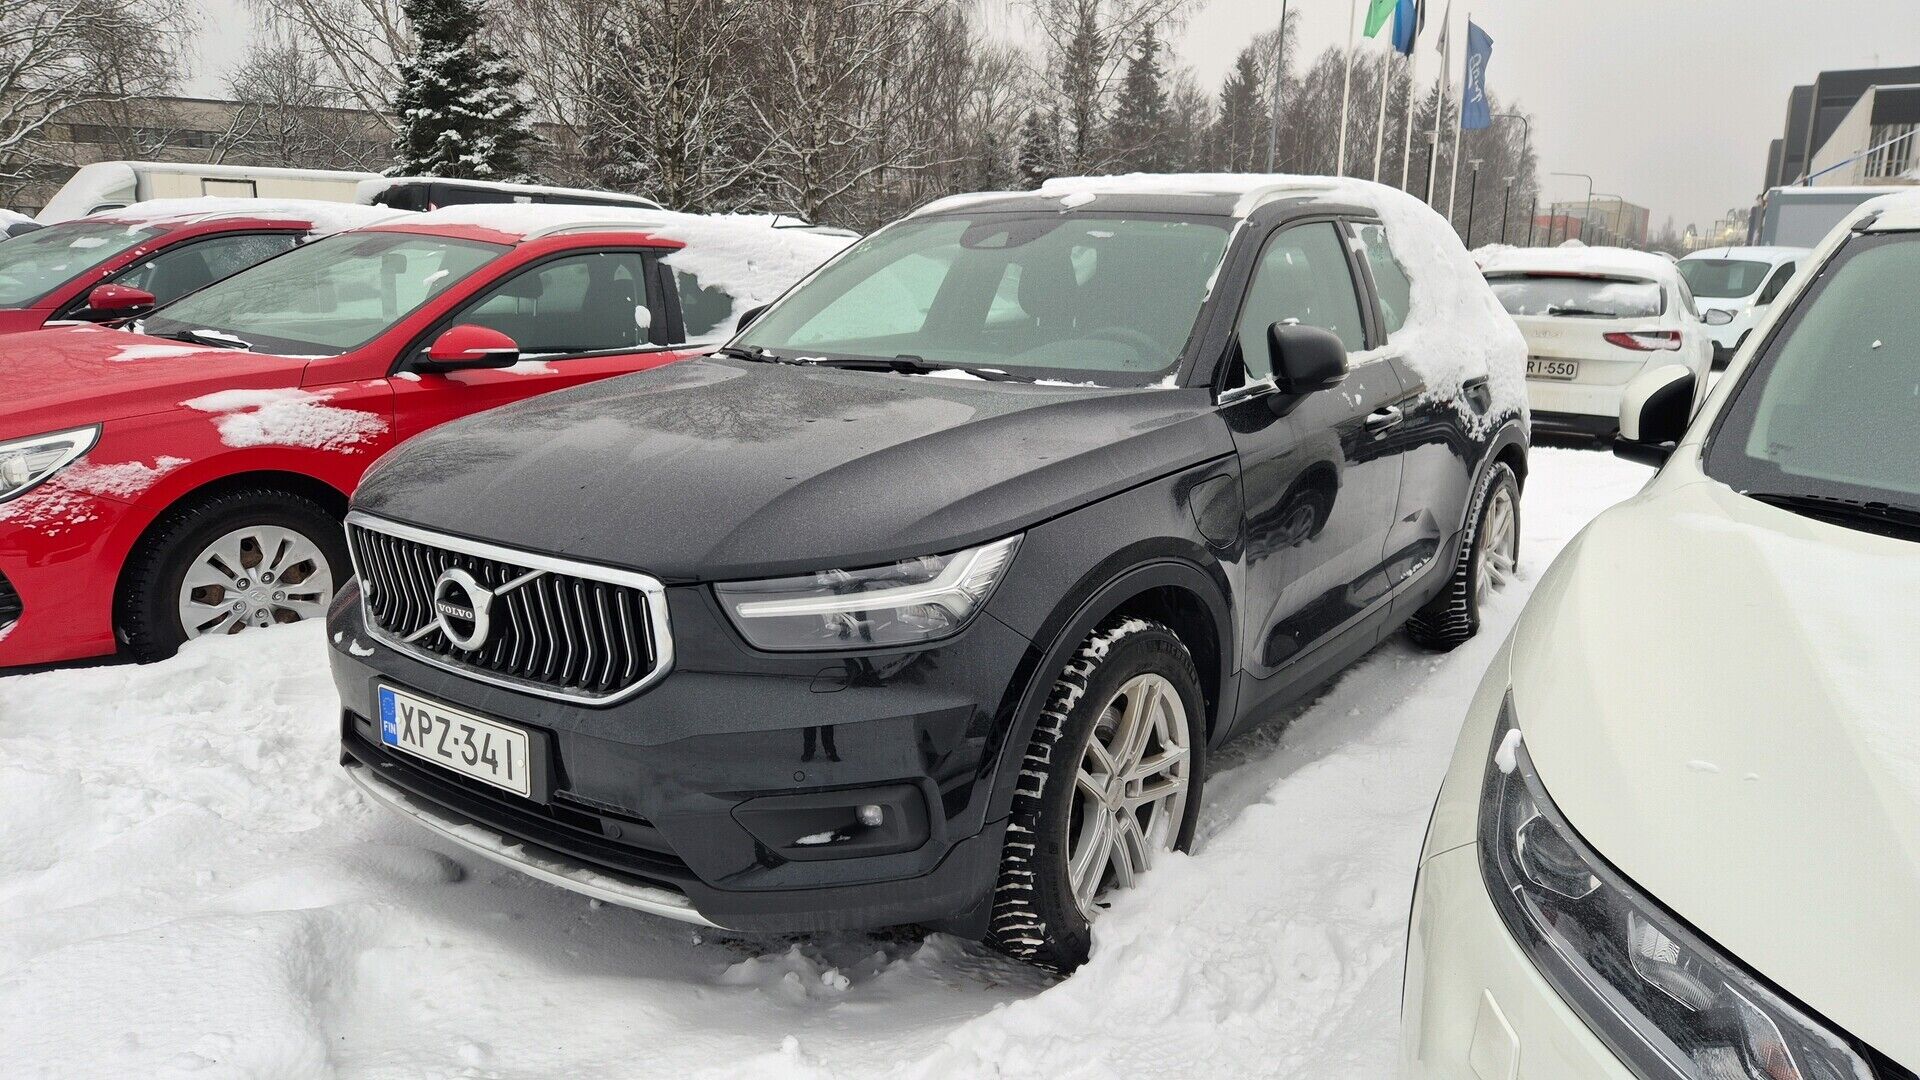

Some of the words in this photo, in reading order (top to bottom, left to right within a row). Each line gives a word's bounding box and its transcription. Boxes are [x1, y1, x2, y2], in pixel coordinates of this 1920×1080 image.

[1526, 361, 1575, 376] RI-550
[437, 603, 473, 620] VOLVO
[383, 720, 397, 735] FIN
[400, 702, 513, 781] XPZ-341
